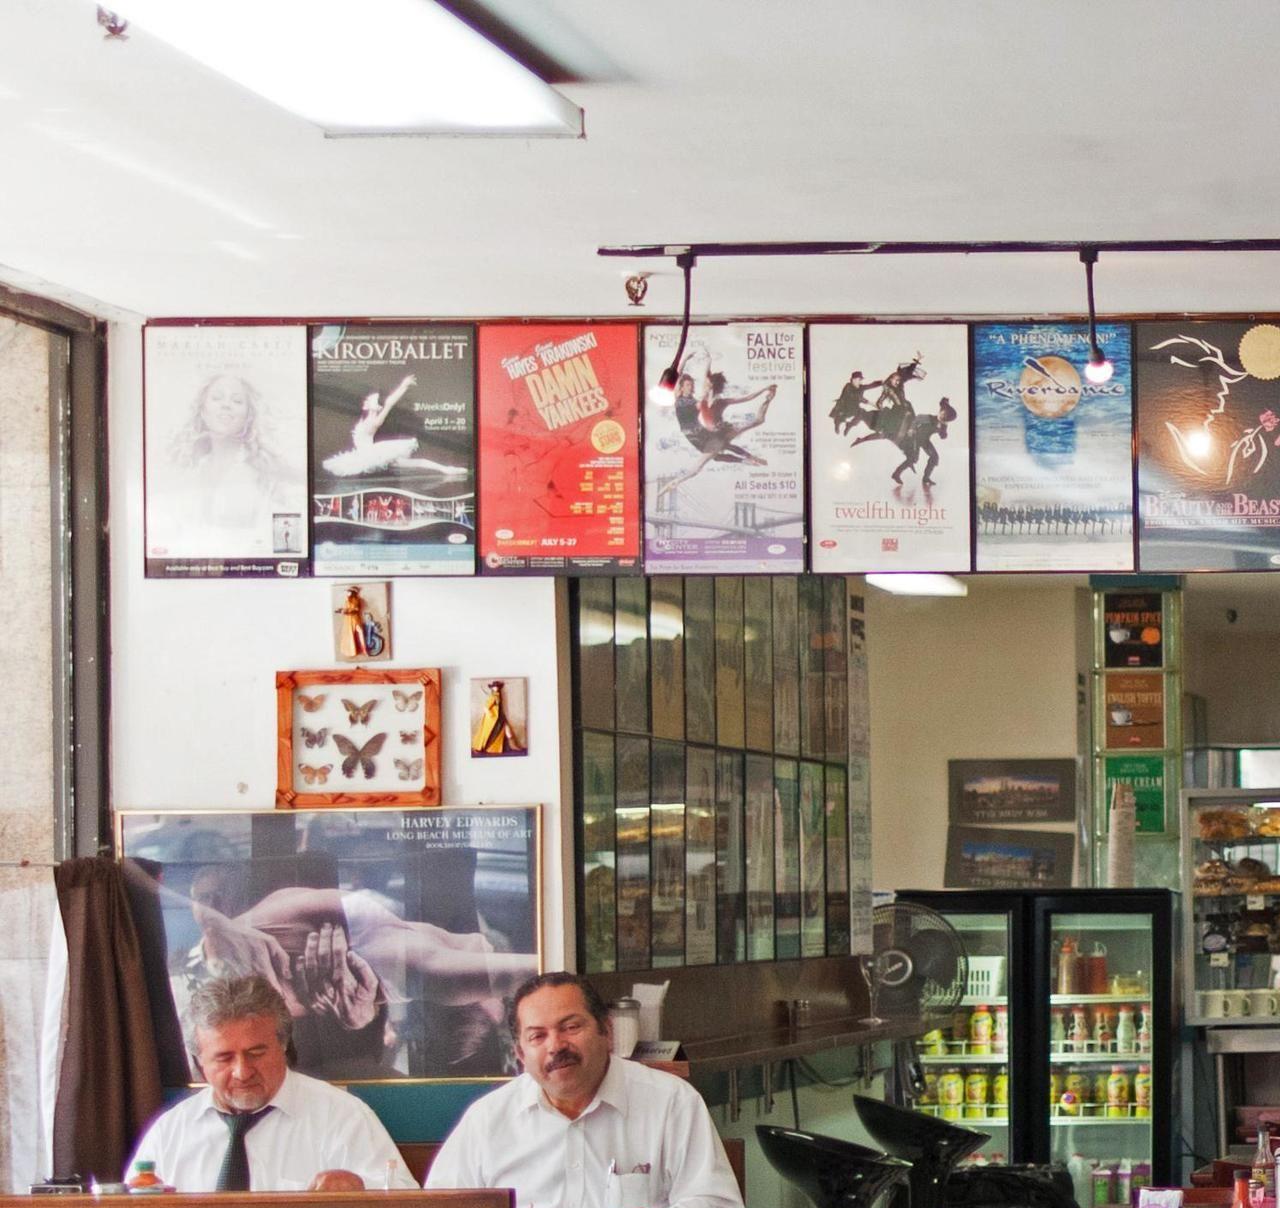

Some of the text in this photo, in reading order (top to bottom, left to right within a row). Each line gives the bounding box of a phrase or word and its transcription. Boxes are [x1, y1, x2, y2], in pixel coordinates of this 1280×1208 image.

[746, 332, 795, 346] FALL for
[747, 347, 795, 360] DANCE
[749, 360, 796, 372] festival
[525, 352, 600, 409] DAMN
[987, 380, 1125, 398] Riverdance
[538, 386, 609, 431] YANKEES
[735, 480, 797, 490] All Seats $10
[1144, 495, 1216, 516] BEAUTY
[835, 501, 947, 526] twelfth night
[1104, 611, 1162, 624] PUMPKIN SPICE
[1106, 692, 1162, 705] ENGLISH TOFFEE
[1134, 776, 1162, 788] CREAM
[400, 815, 518, 828] HARVEY EDWARDS
[387, 829, 532, 841] LONG BEACH MUSEUM OF ART
